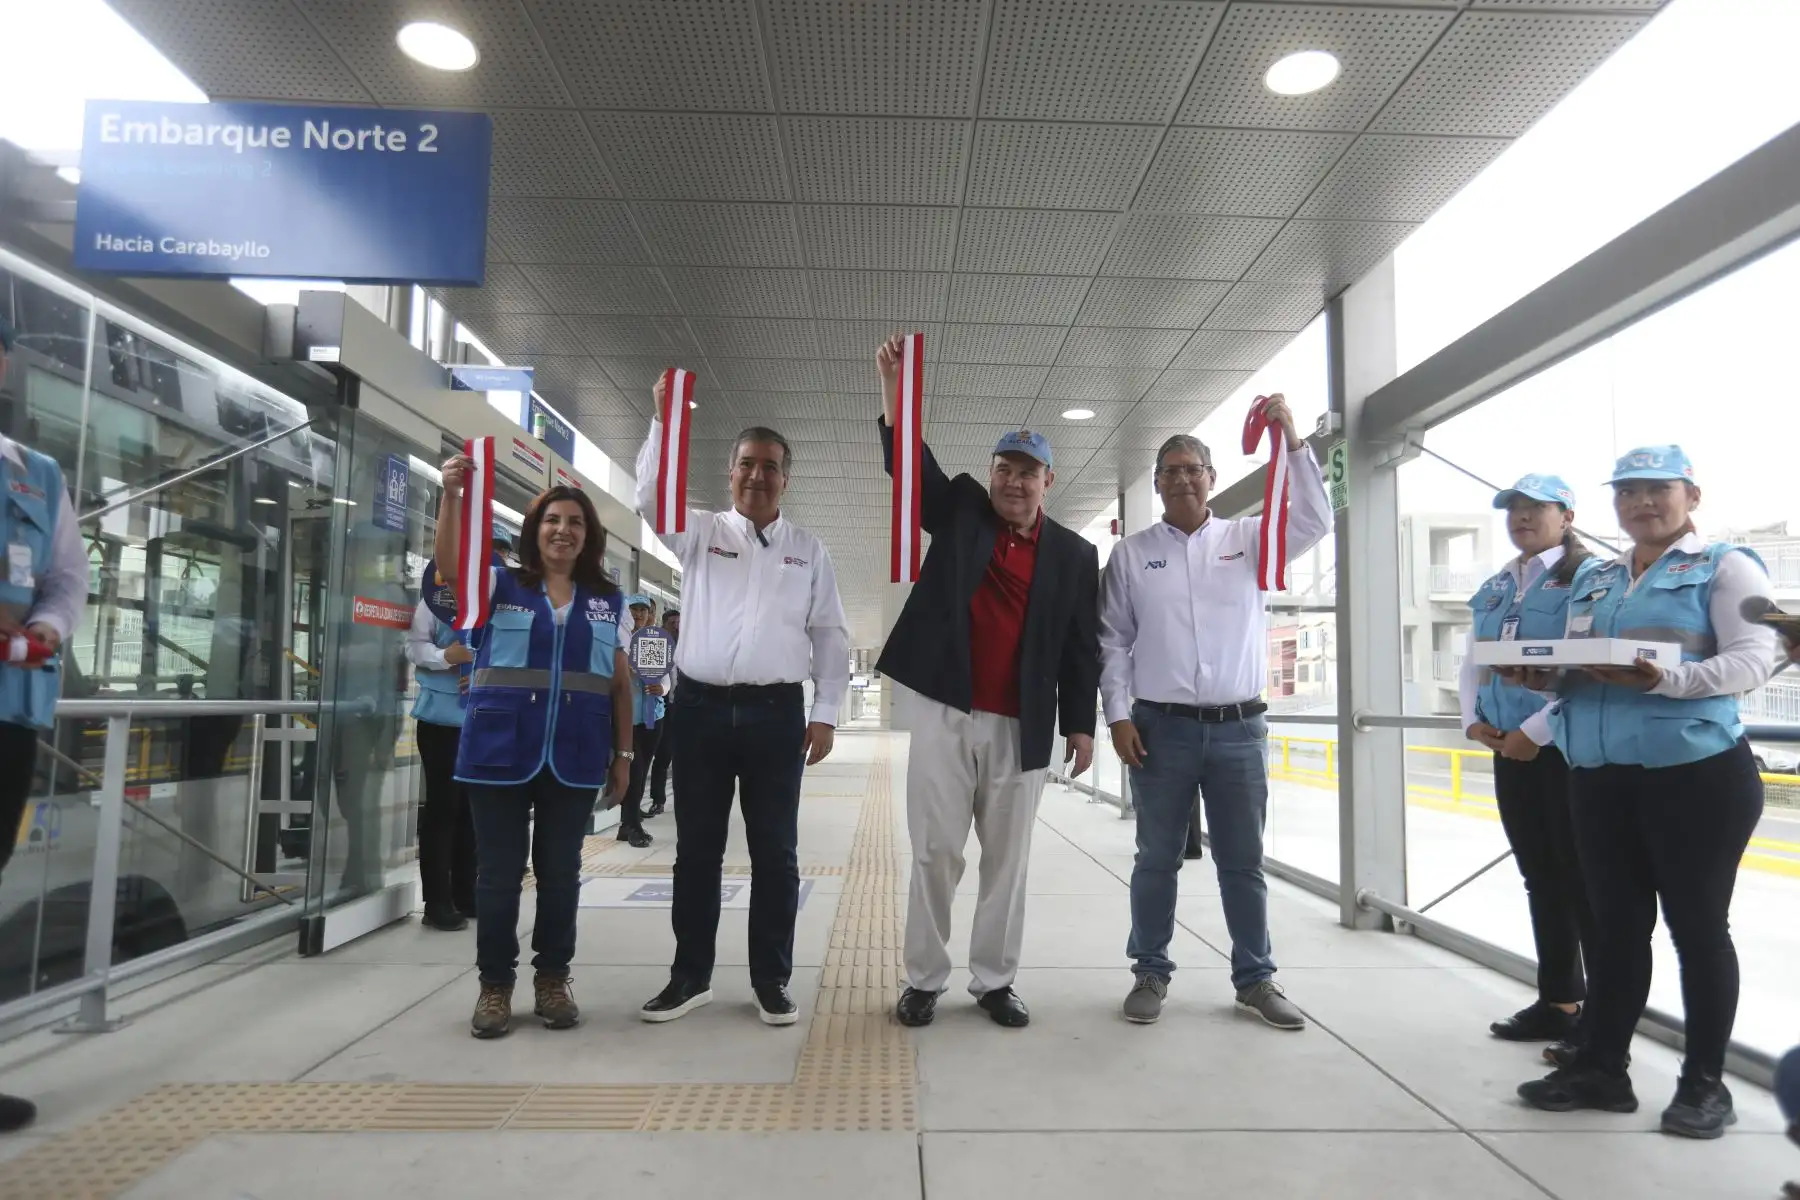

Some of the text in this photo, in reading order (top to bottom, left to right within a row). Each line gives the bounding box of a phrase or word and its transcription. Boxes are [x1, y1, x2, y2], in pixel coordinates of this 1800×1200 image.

[100, 113, 438, 154] Embarque Norte 2
[95, 233, 271, 261] Hacia Carabayllo
[1333, 448, 1344, 483] S
[586, 613, 617, 624] LIMA
